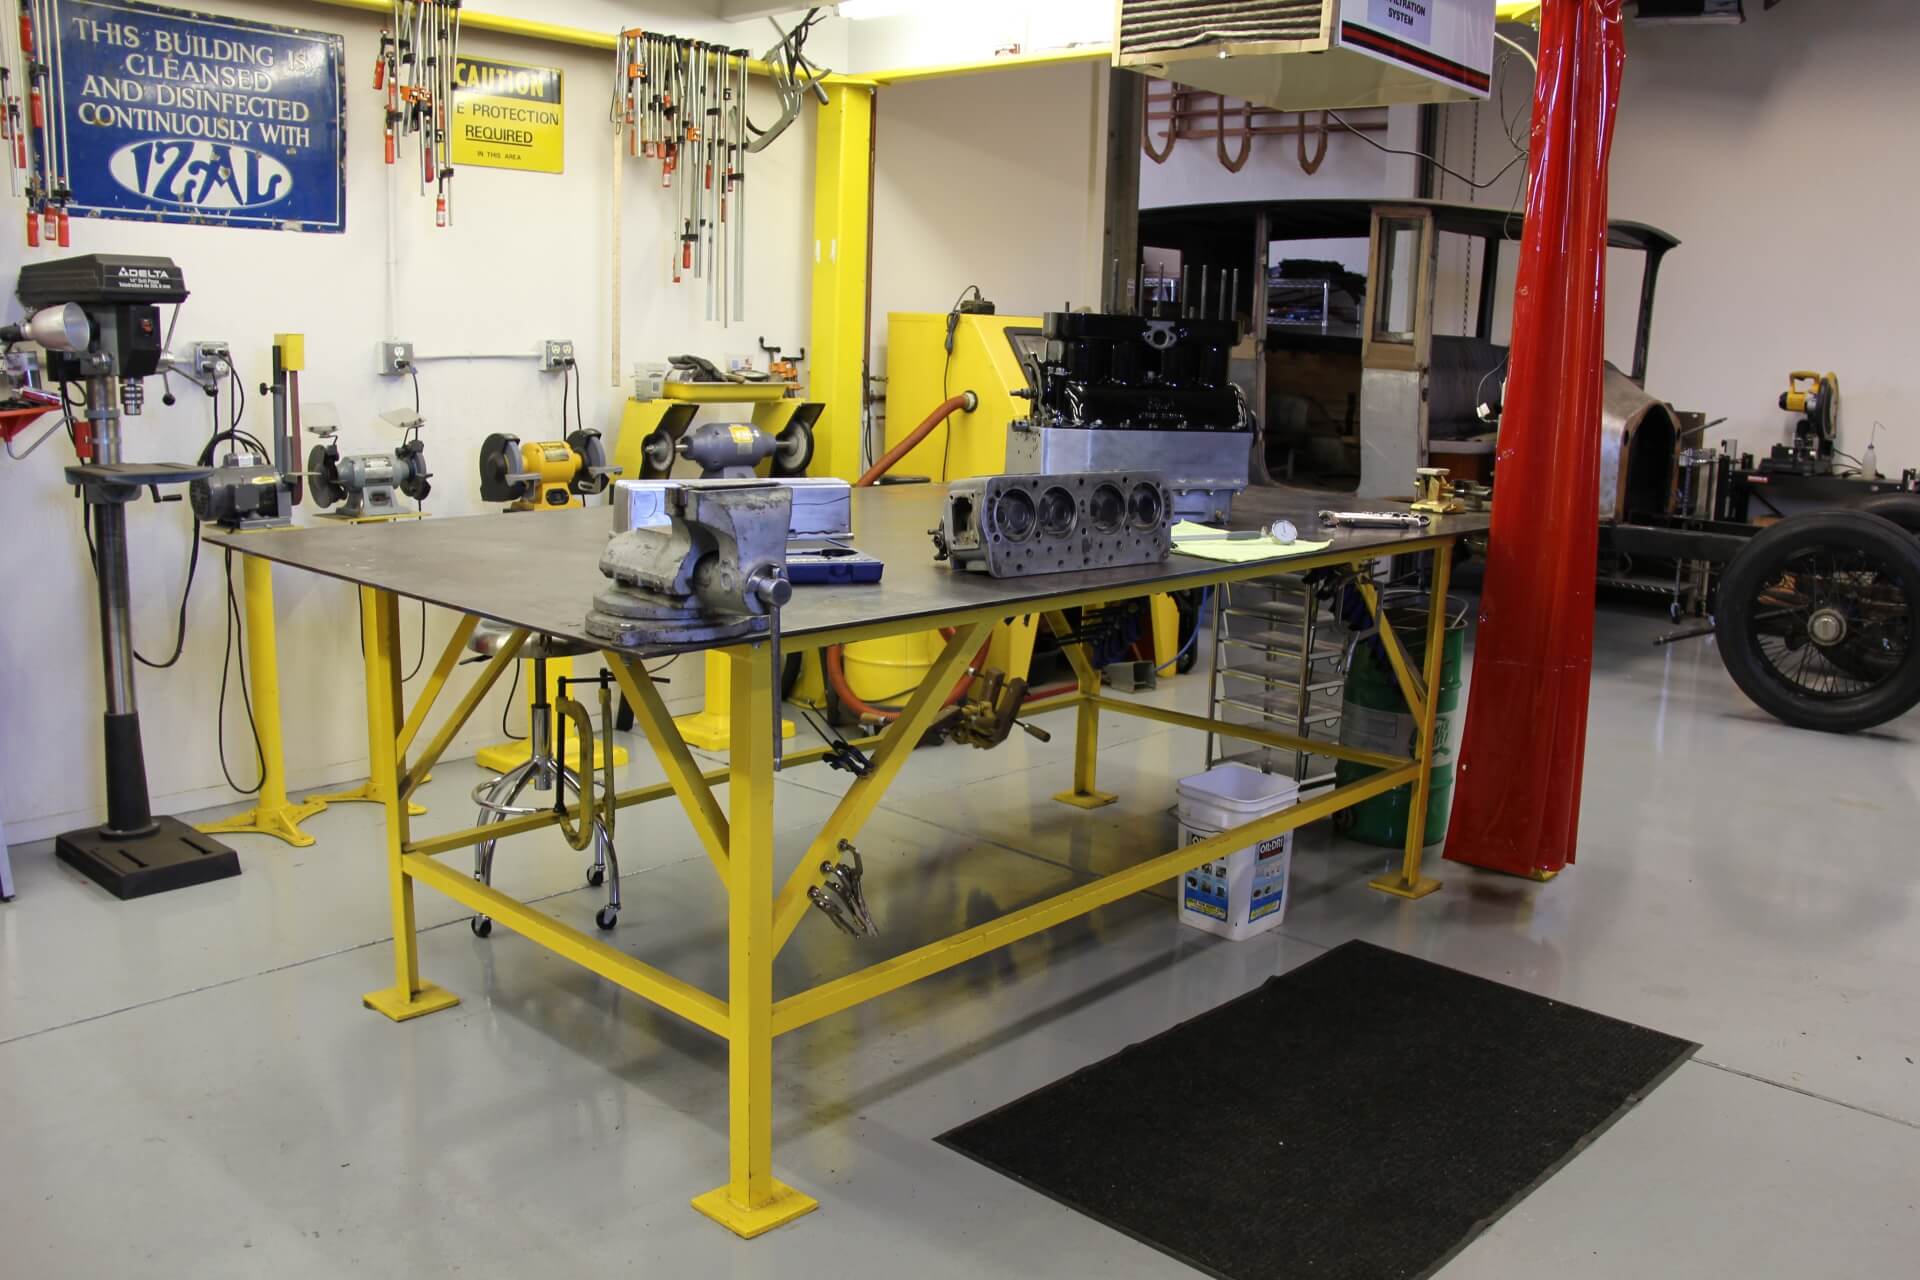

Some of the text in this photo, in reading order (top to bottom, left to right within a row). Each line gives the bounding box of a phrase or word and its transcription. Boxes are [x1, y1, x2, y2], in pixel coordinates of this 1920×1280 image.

[1388, 0, 1426, 17] ILTRATION
[1388, 7, 1414, 26] SYSTEM
[72, 17, 308, 73] THIS BUILDING IS
[126, 53, 273, 93] CLEANSED
[455, 62, 544, 97] CAUTION
[81, 74, 310, 122] AND DISINFECTED
[78, 102, 311, 148] CONTINUOUSLY WITH
[472, 103, 559, 126] PROTECTION
[465, 124, 534, 144] REQUIRED
[487, 151, 501, 159] THIS
[130, 140, 283, 206] IZAL
[129, 269, 169, 278] DELTA
